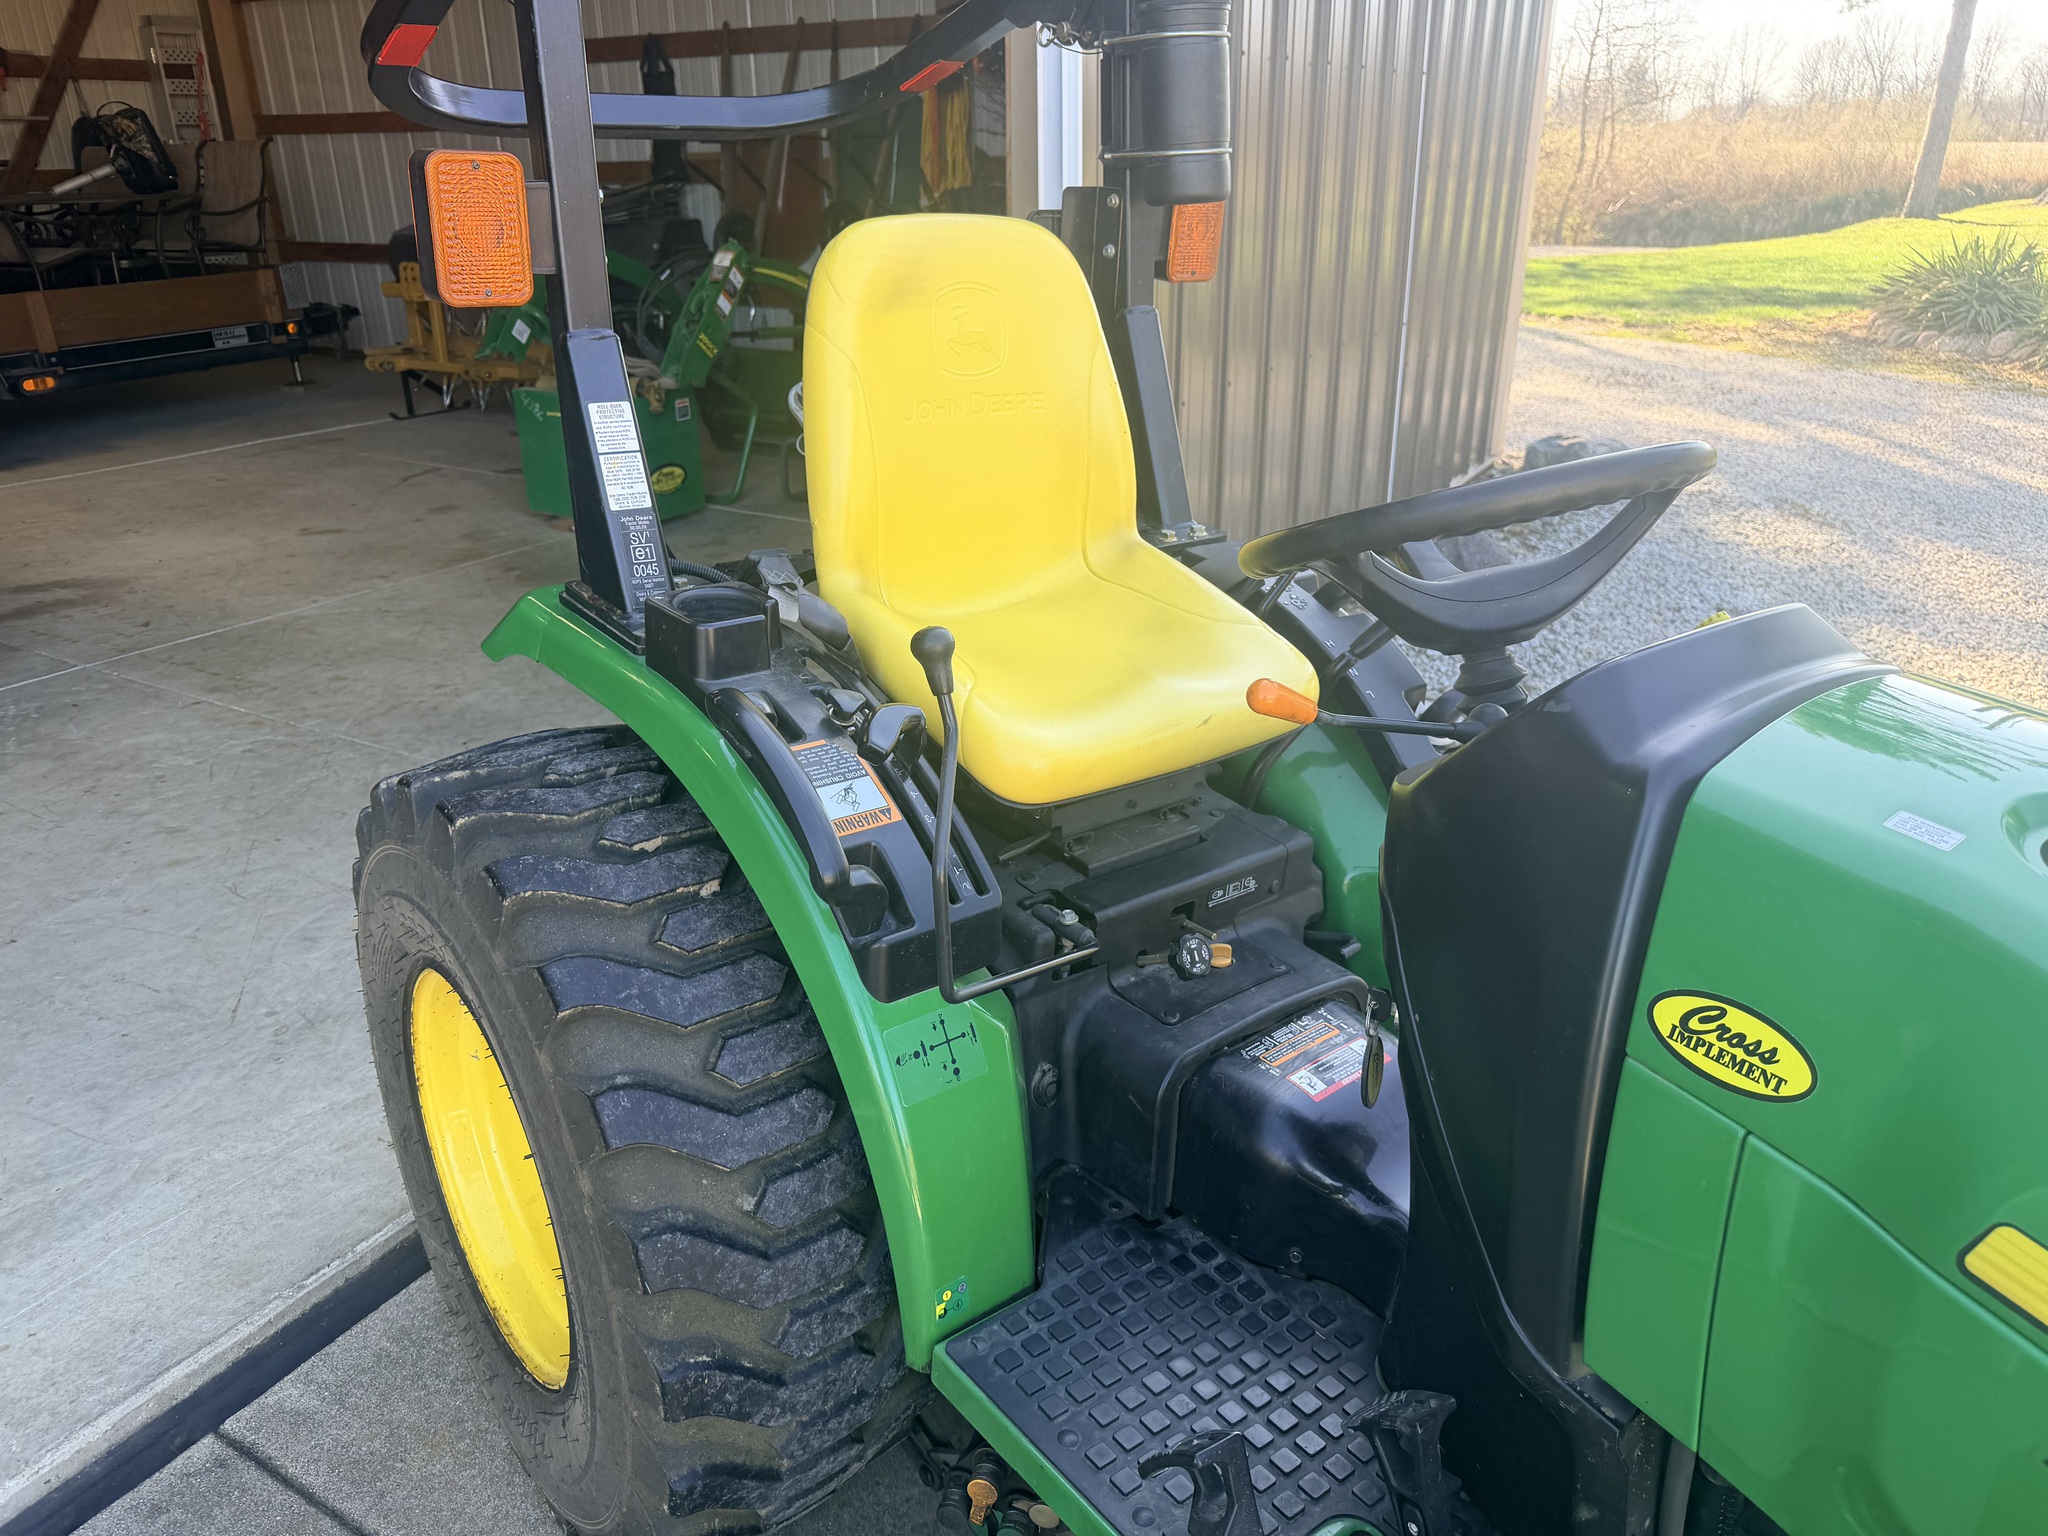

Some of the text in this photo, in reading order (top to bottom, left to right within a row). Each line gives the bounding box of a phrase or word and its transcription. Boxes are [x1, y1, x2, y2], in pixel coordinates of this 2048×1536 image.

[903, 391, 1046, 425] JOHN DEERE
[635, 547, 651, 559] e1
[633, 563, 659, 577] 0045
[1324, 640, 1335, 648] H
[812, 769, 866, 786] AVOID CRUSHIN
[833, 811, 883, 833] WARNIN
[1182, 950, 1190, 968] CLOSE
[1679, 1005, 1781, 1065] Cross
[1666, 1023, 1788, 1094] IMPLEMENT
